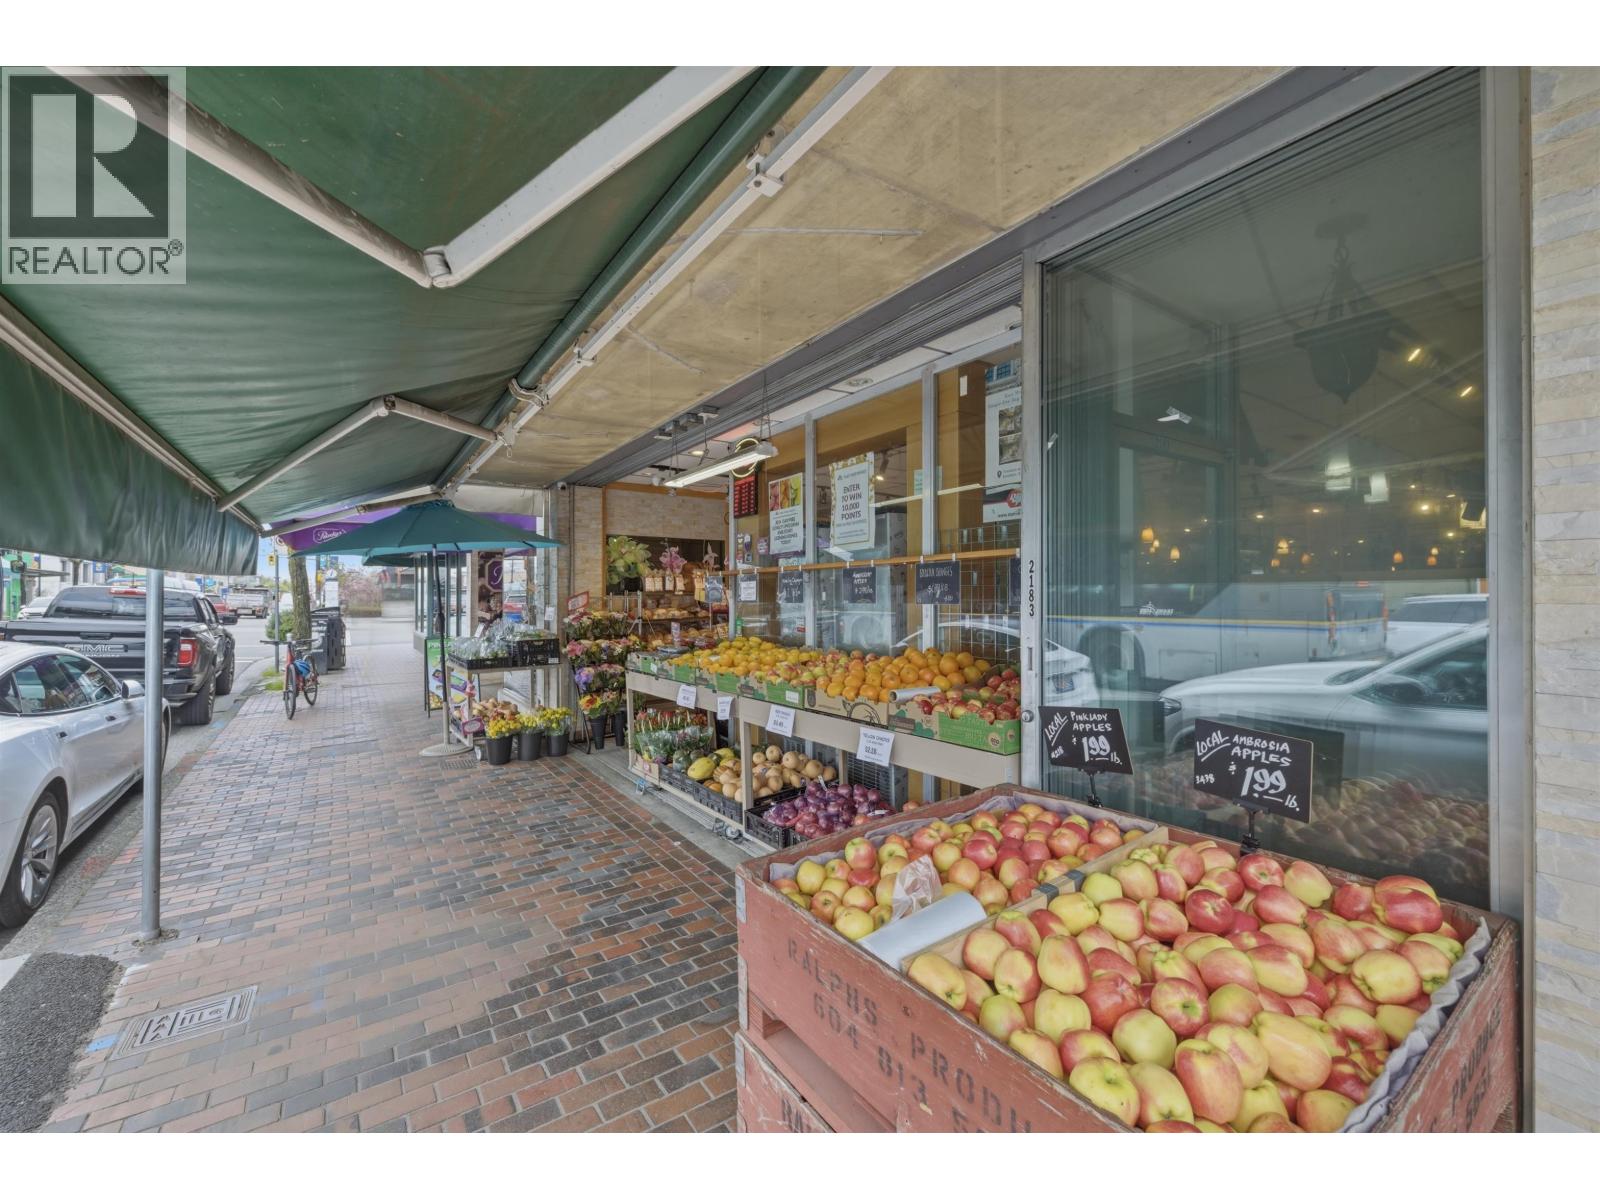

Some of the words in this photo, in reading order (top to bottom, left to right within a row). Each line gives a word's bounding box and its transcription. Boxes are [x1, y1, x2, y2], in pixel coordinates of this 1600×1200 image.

[843, 483, 861, 494] ENTER
[849, 492, 862, 501] WIN
[841, 511, 862, 520] POINTS
[1044, 712, 1068, 741] LOCAL
[1072, 722, 1113, 732] APPLES
[1196, 730, 1230, 756] LOCAL
[1232, 734, 1291, 754] AMBROSIA
[1231, 746, 1293, 767] APPLES
[788, 938, 878, 1026] RALPHS
[813, 992, 859, 1049] 604
